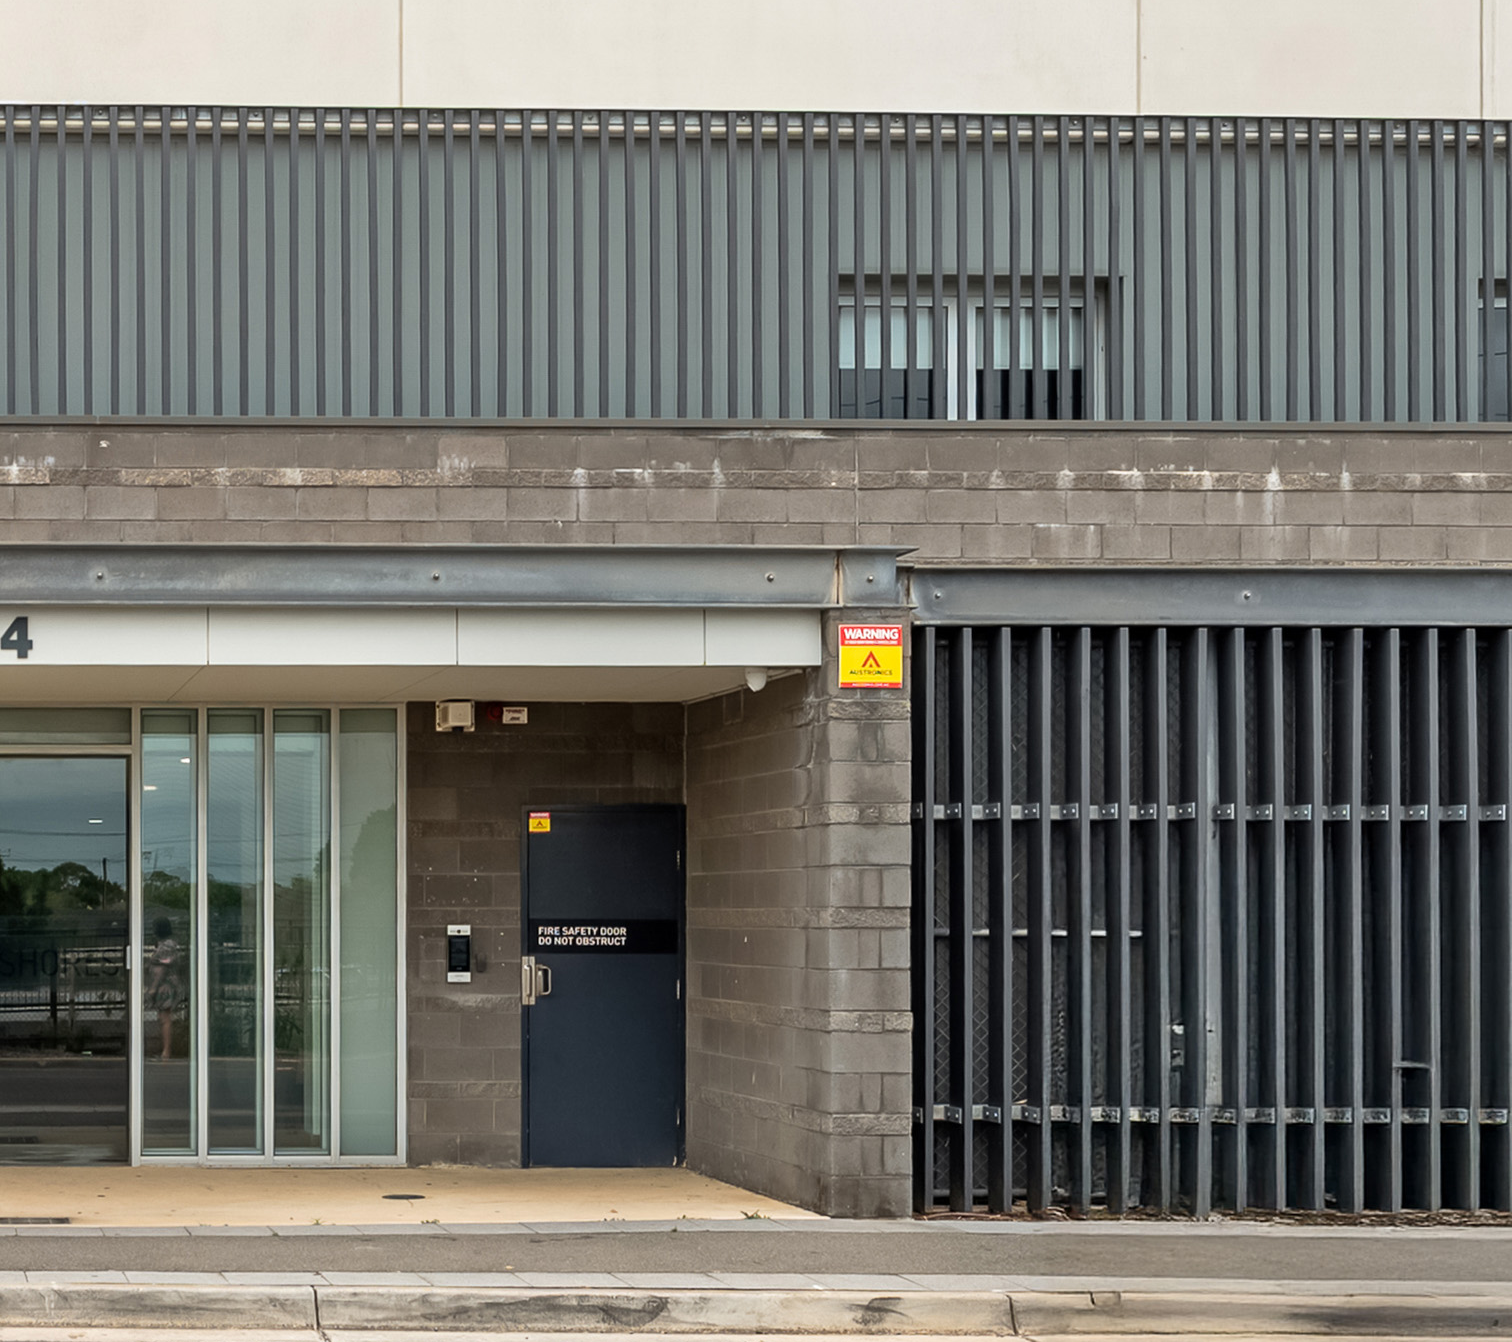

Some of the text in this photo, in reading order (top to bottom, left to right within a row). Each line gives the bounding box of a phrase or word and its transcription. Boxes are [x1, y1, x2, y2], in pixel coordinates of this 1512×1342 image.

[844, 628, 899, 640] WARNING
[538, 926, 627, 936] FIRE SAFETY DOOR
[538, 936, 627, 946] DO NOT OBSTRUCT
